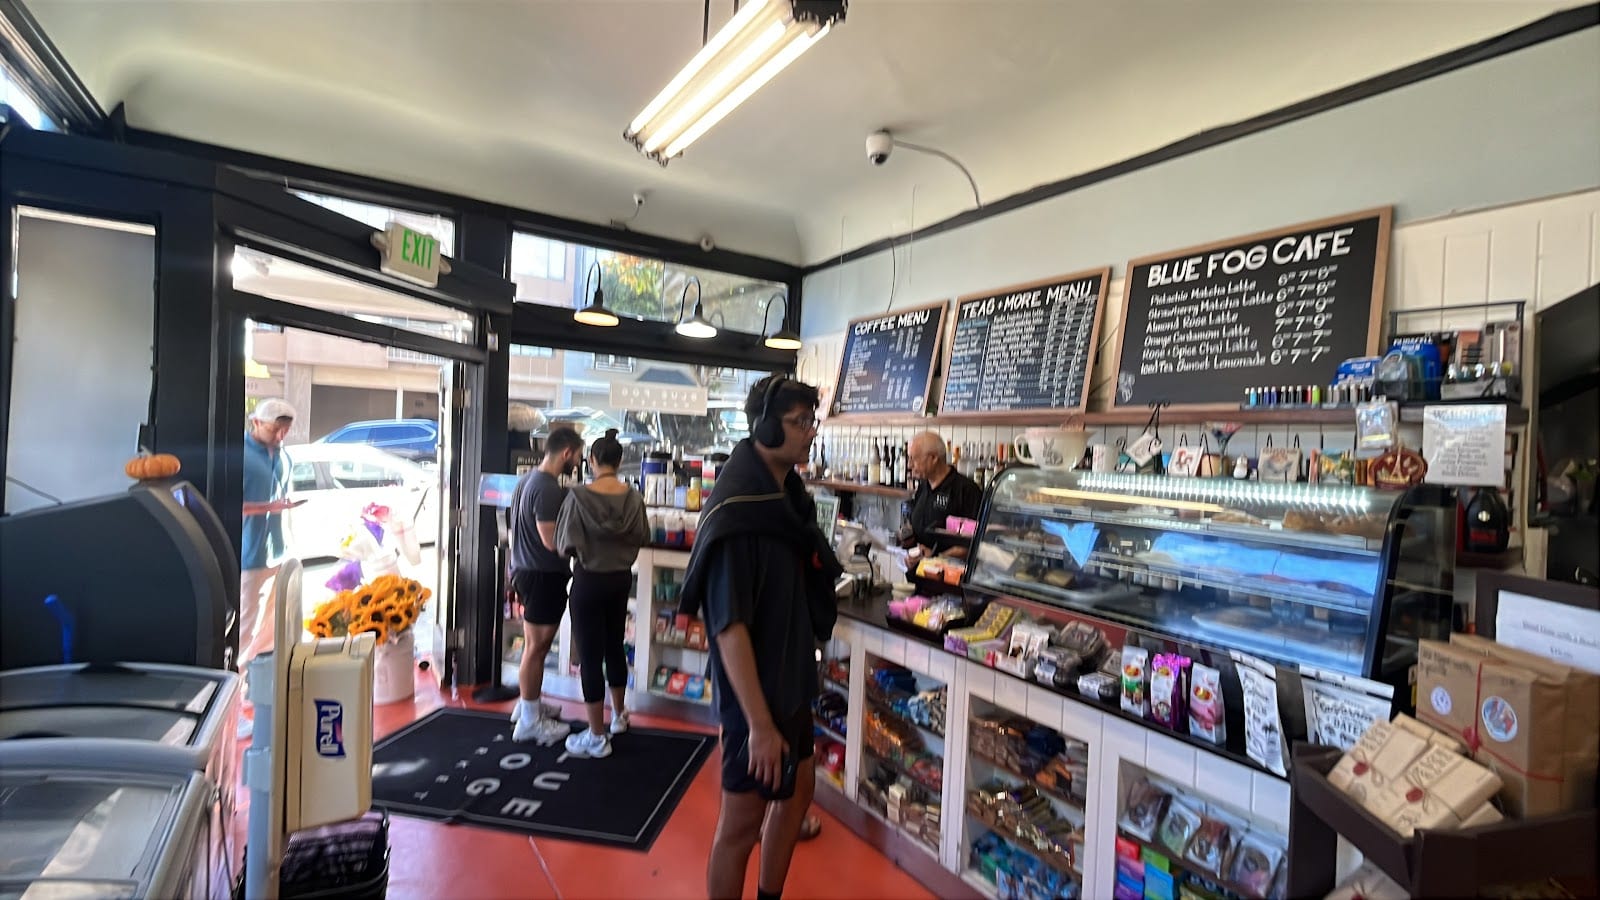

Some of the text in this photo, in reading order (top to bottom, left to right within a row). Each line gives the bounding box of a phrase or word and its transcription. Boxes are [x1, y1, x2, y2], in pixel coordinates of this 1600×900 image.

[402, 228, 435, 270] EXIT
[1147, 228, 1354, 288] BLUE FOG CAFE
[1003, 290, 1042, 312] MORE
[1045, 279, 1092, 305] MENU
[1190, 284, 1226, 300] Matcha
[1227, 278, 1257, 294] Latte
[1200, 296, 1240, 312] Matcha
[1242, 289, 1274, 307] Latte
[854, 309, 930, 336] COFFEE MENU
[1146, 316, 1179, 334] Almond
[1208, 309, 1239, 326] Latte
[1222, 323, 1251, 338] Latte
[1225, 336, 1258, 354] Latte
[1213, 349, 1266, 370] Lemonade
[319, 704, 341, 755] Purell
